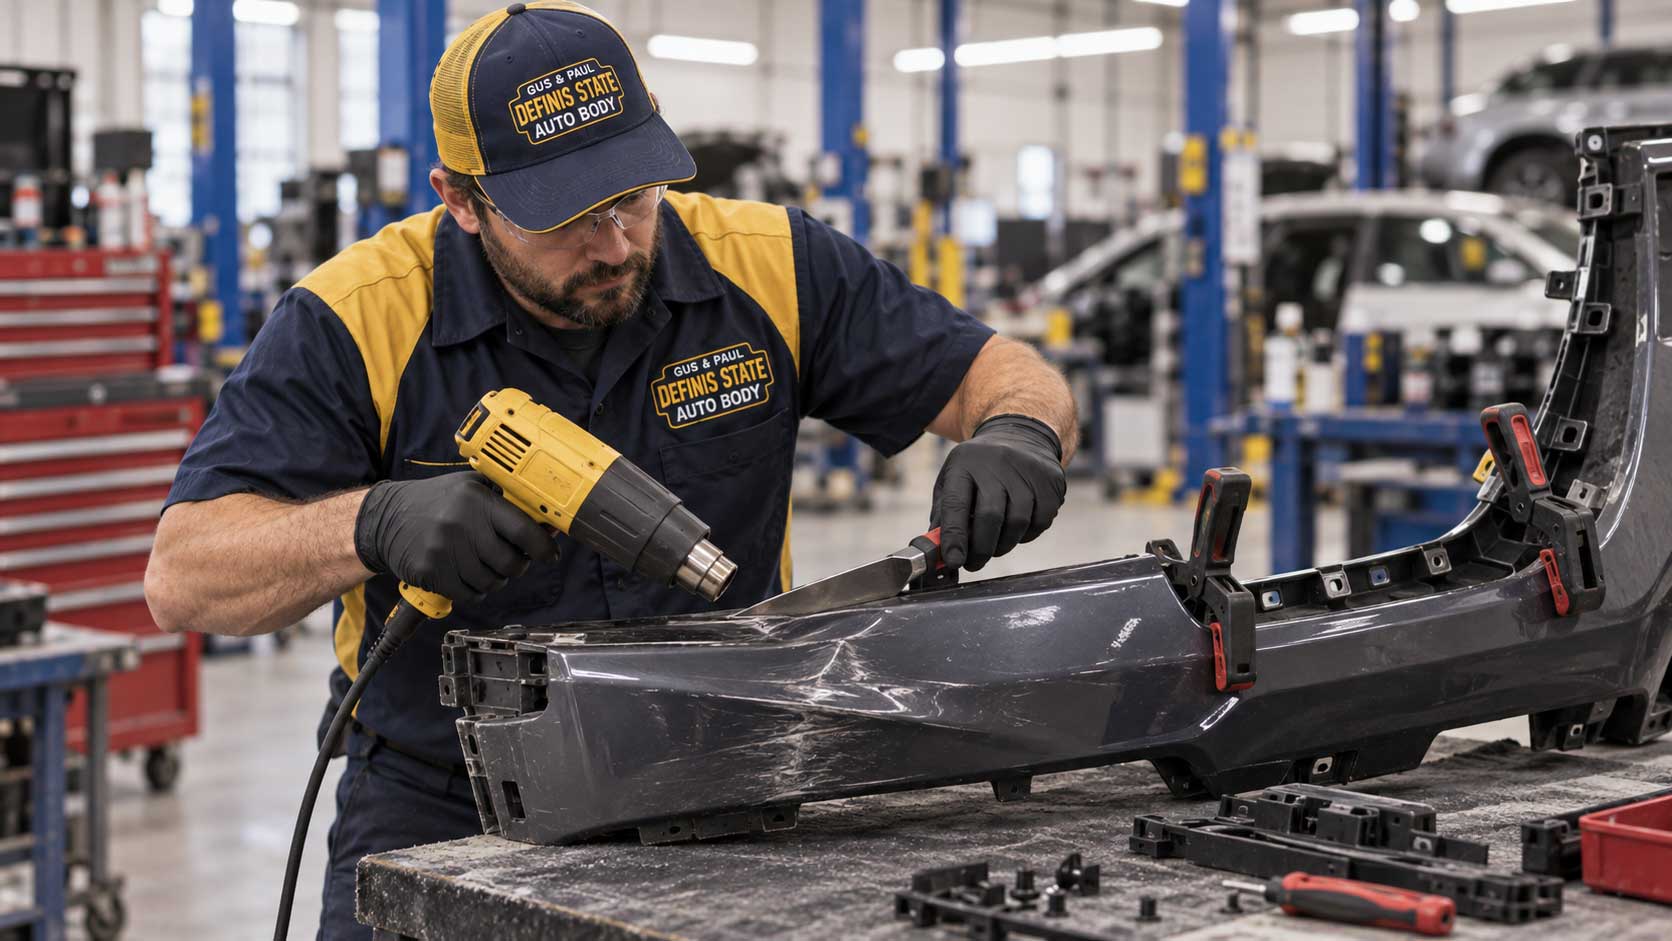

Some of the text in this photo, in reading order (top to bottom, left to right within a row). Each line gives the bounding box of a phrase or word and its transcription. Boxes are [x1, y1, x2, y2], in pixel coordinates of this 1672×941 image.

[514, 71, 619, 127] DEFINIS STATE
[527, 64, 595, 95] GUS & PAUL
[535, 96, 615, 139] AUTO BODY
[657, 357, 768, 408] DEFINIS STATE
[673, 349, 744, 377] GUS & PAUL
[676, 383, 760, 422] AUTO BODY
